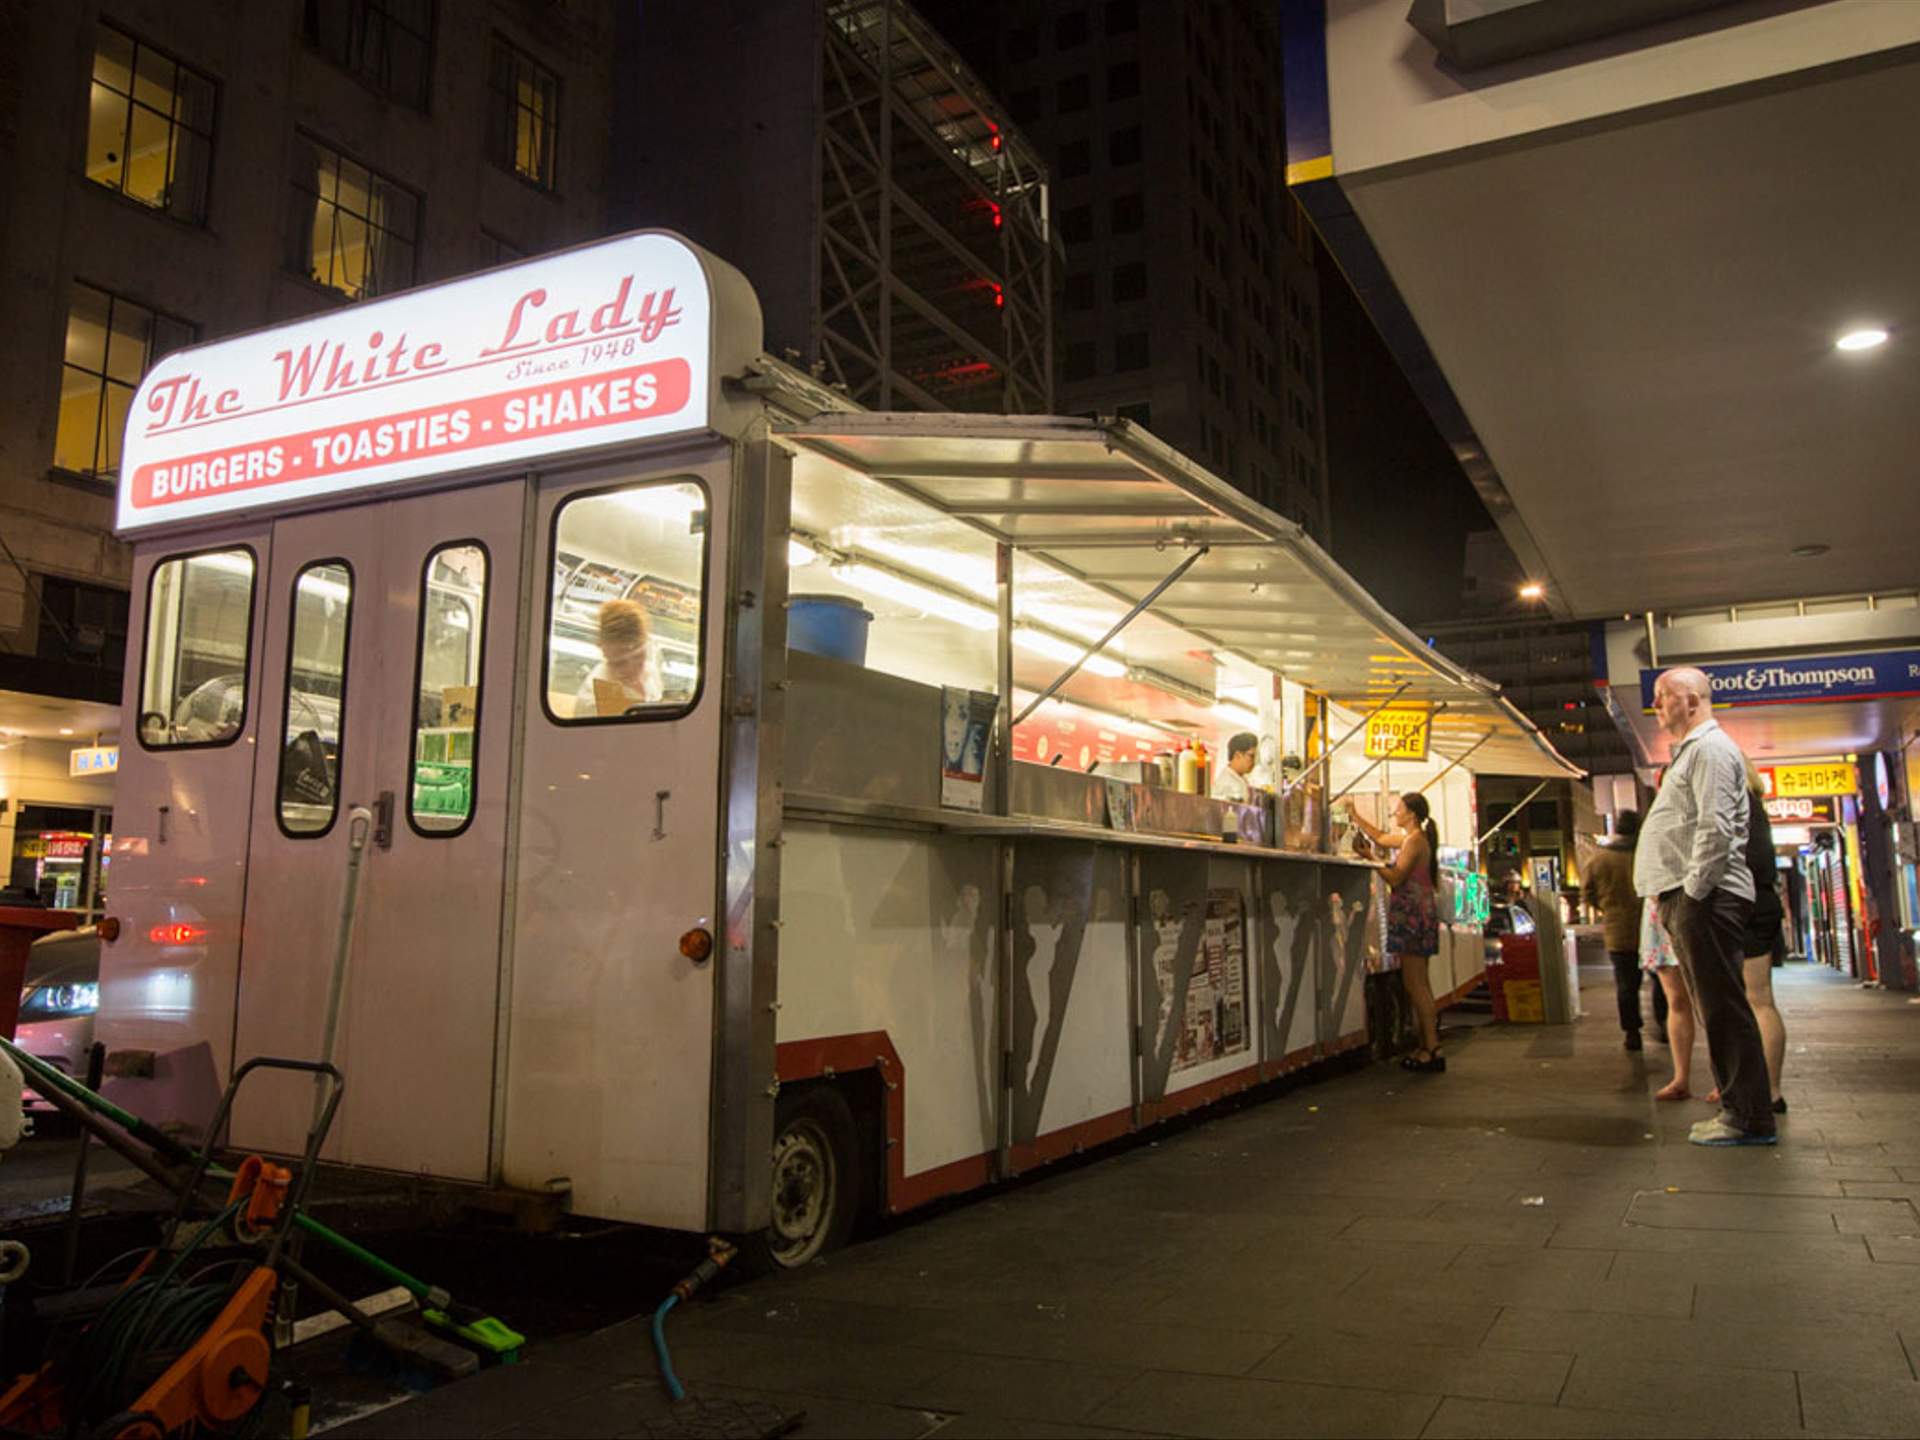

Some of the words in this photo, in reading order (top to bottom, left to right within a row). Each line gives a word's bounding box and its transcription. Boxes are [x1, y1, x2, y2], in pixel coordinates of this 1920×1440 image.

[145, 373, 245, 431] The
[272, 331, 449, 402] White
[479, 273, 683, 358] Lady
[506, 357, 573, 382] Since
[580, 337, 636, 366] 1948
[151, 445, 285, 499] BURGERS
[311, 408, 472, 469] TOASTIES
[503, 372, 658, 434] SHAKES
[1370, 737, 1420, 752] HERE
[1371, 723, 1421, 737] ORDER
[1782, 769, 1848, 791] 슈퍼마켓
